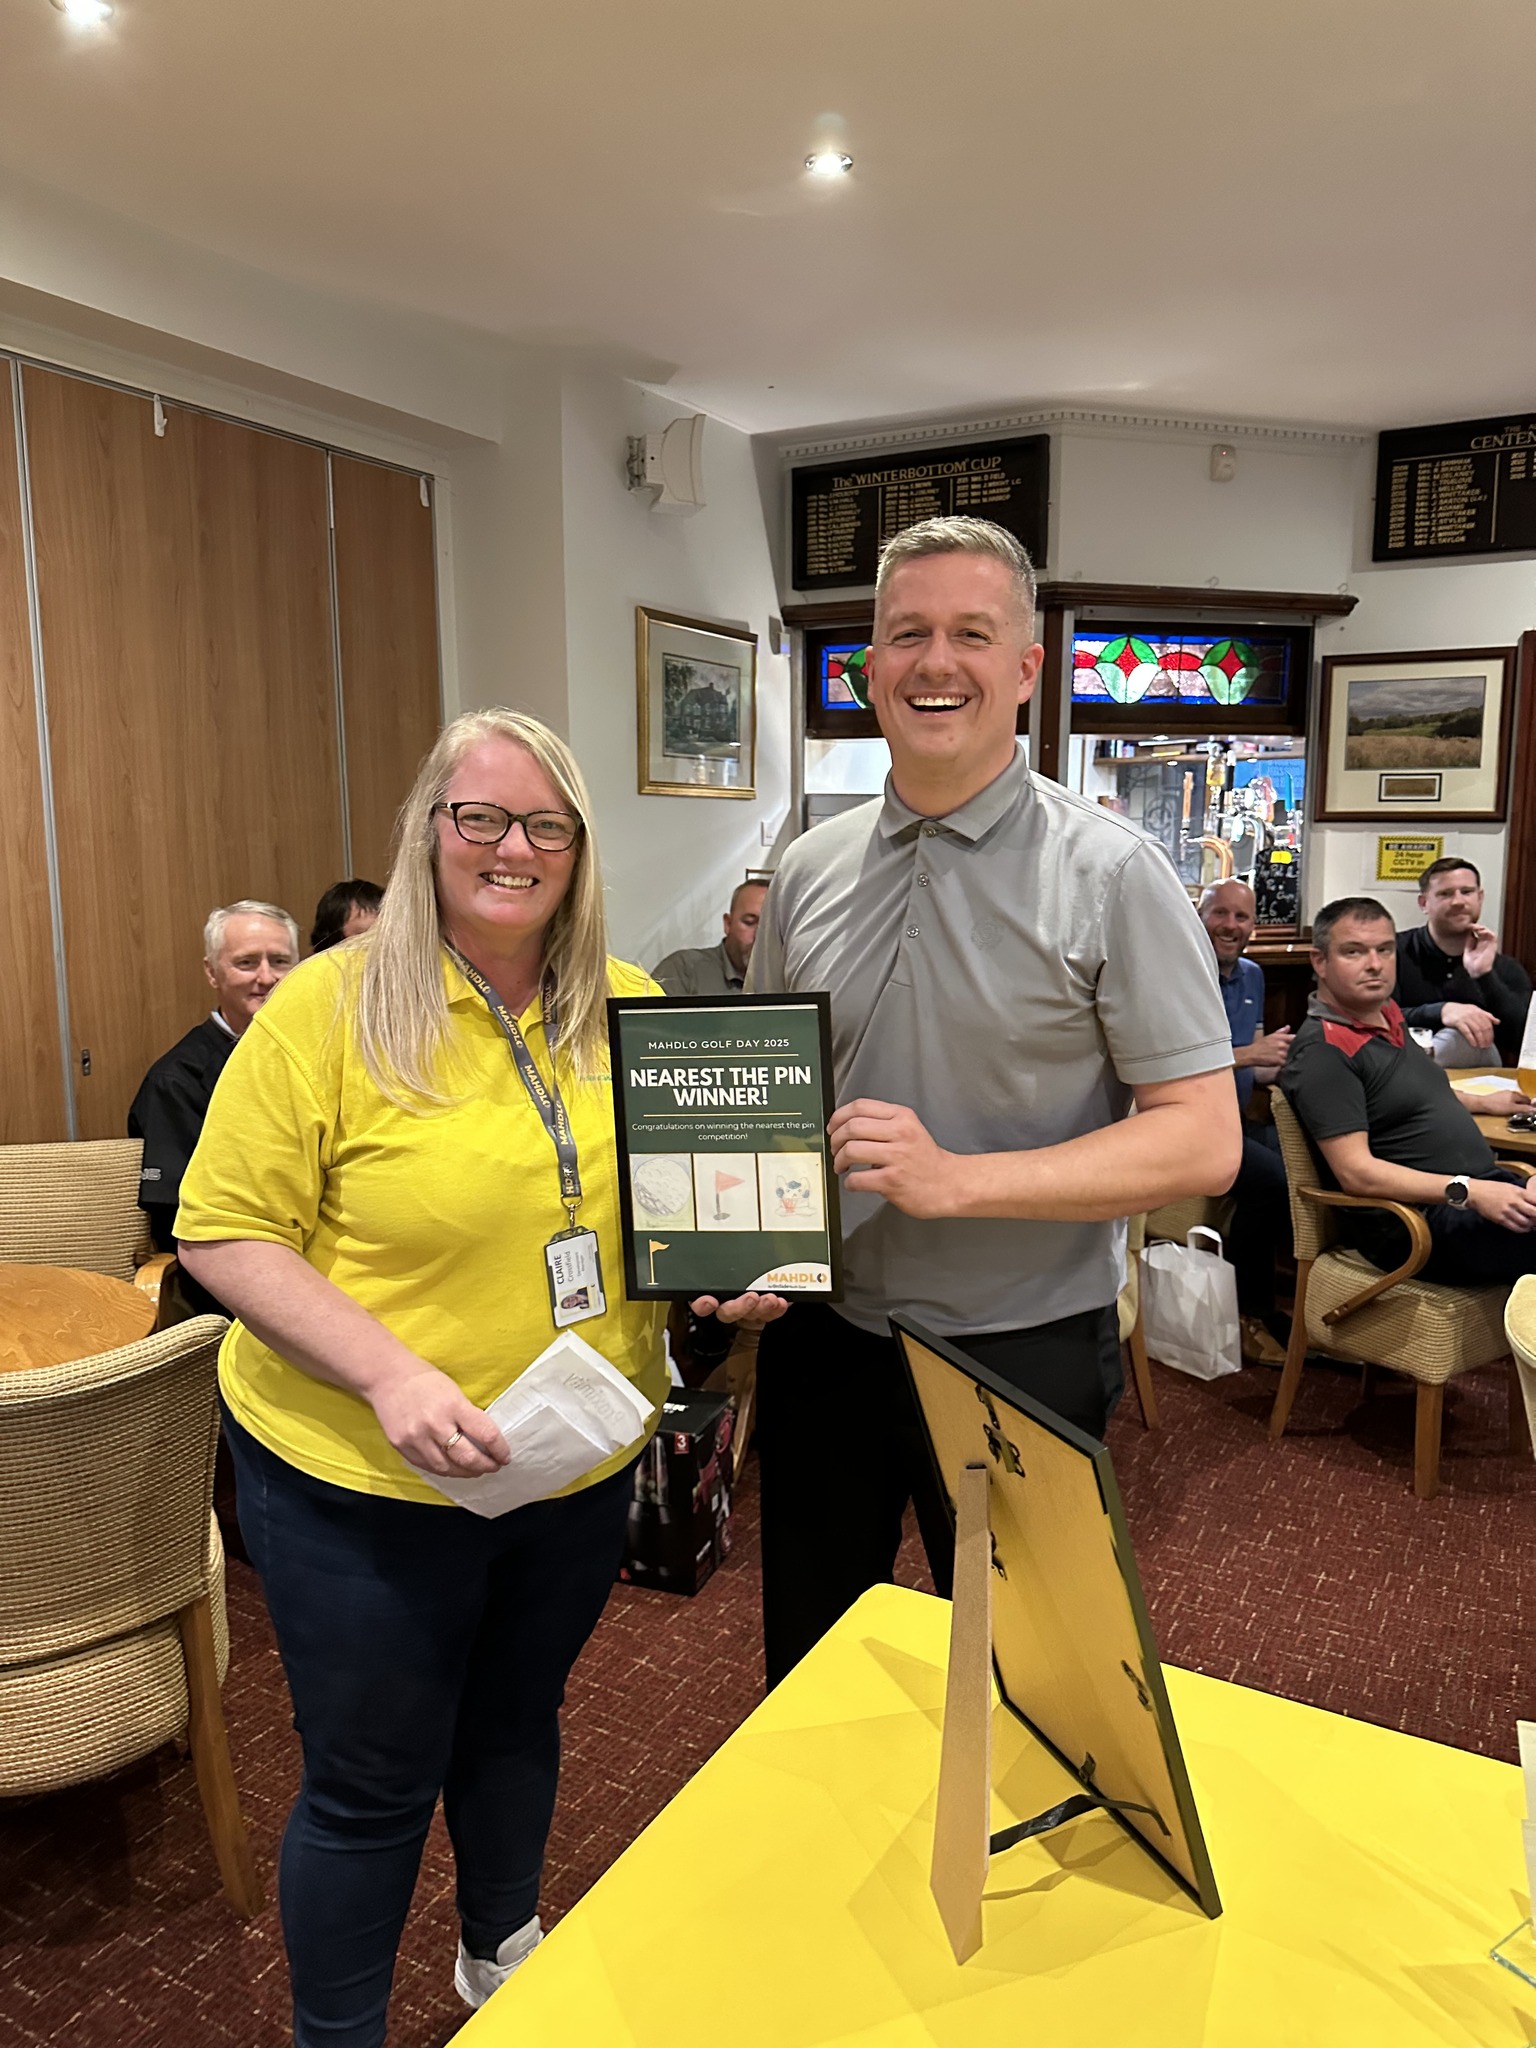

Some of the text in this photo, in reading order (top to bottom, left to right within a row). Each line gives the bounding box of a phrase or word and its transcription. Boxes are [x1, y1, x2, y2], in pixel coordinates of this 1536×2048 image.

[832, 476, 853, 489] The
[970, 456, 1002, 471] CUP
[497, 1005, 524, 1049] MAHDLO
[648, 1038, 789, 1050] MAHDLO GOLF DAY 2025
[524, 1064, 552, 1109] MAHDLO
[630, 1067, 725, 1088] NEAREST
[728, 1066, 769, 1086] THE
[774, 1065, 812, 1085] PIN
[672, 1086, 768, 1107] WINNER!
[631, 1122, 693, 1132] Congratulations
[706, 1122, 739, 1131] winning
[740, 1121, 754, 1129] the
[786, 1121, 800, 1129] the
[801, 1121, 815, 1130] pin
[697, 1133, 748, 1142] competition!
[554, 1254, 565, 1285] CLAIRE
[564, 1250, 574, 1282] Crossfield
[767, 1272, 827, 1284] MAHDLO
[677, 1435, 687, 1448] 3
